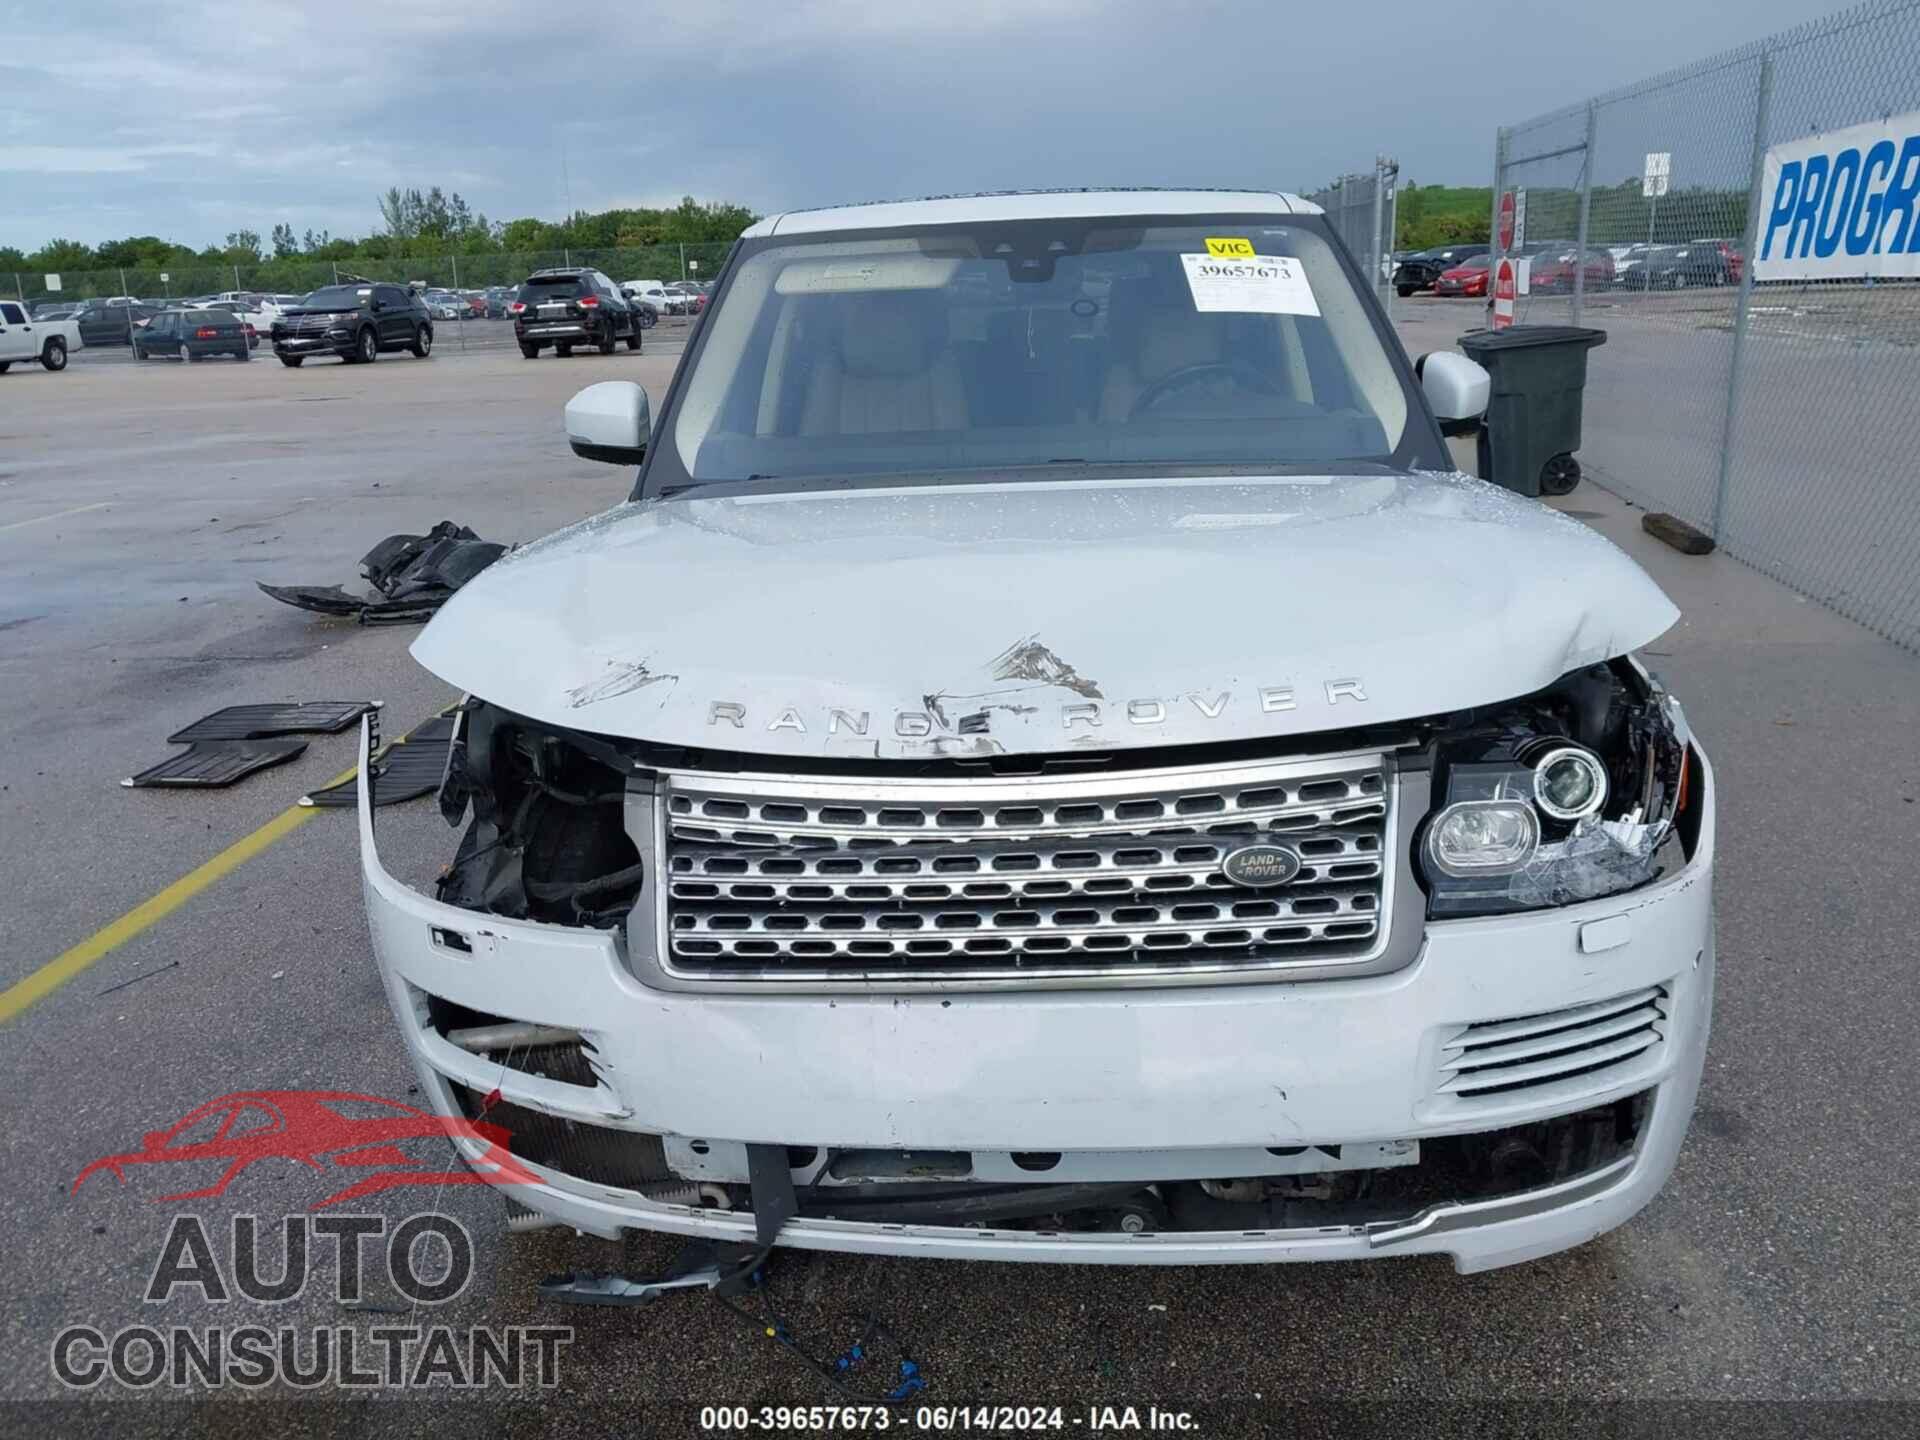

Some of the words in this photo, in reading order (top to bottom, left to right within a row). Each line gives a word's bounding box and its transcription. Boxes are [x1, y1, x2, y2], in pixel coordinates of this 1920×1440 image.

[1760, 135, 1920, 261] PROGR
[1210, 242, 1250, 255] VIC
[1198, 265, 1292, 280] 39657673
[706, 699, 992, 736] RANGE
[1061, 679, 1369, 729] ROVER
